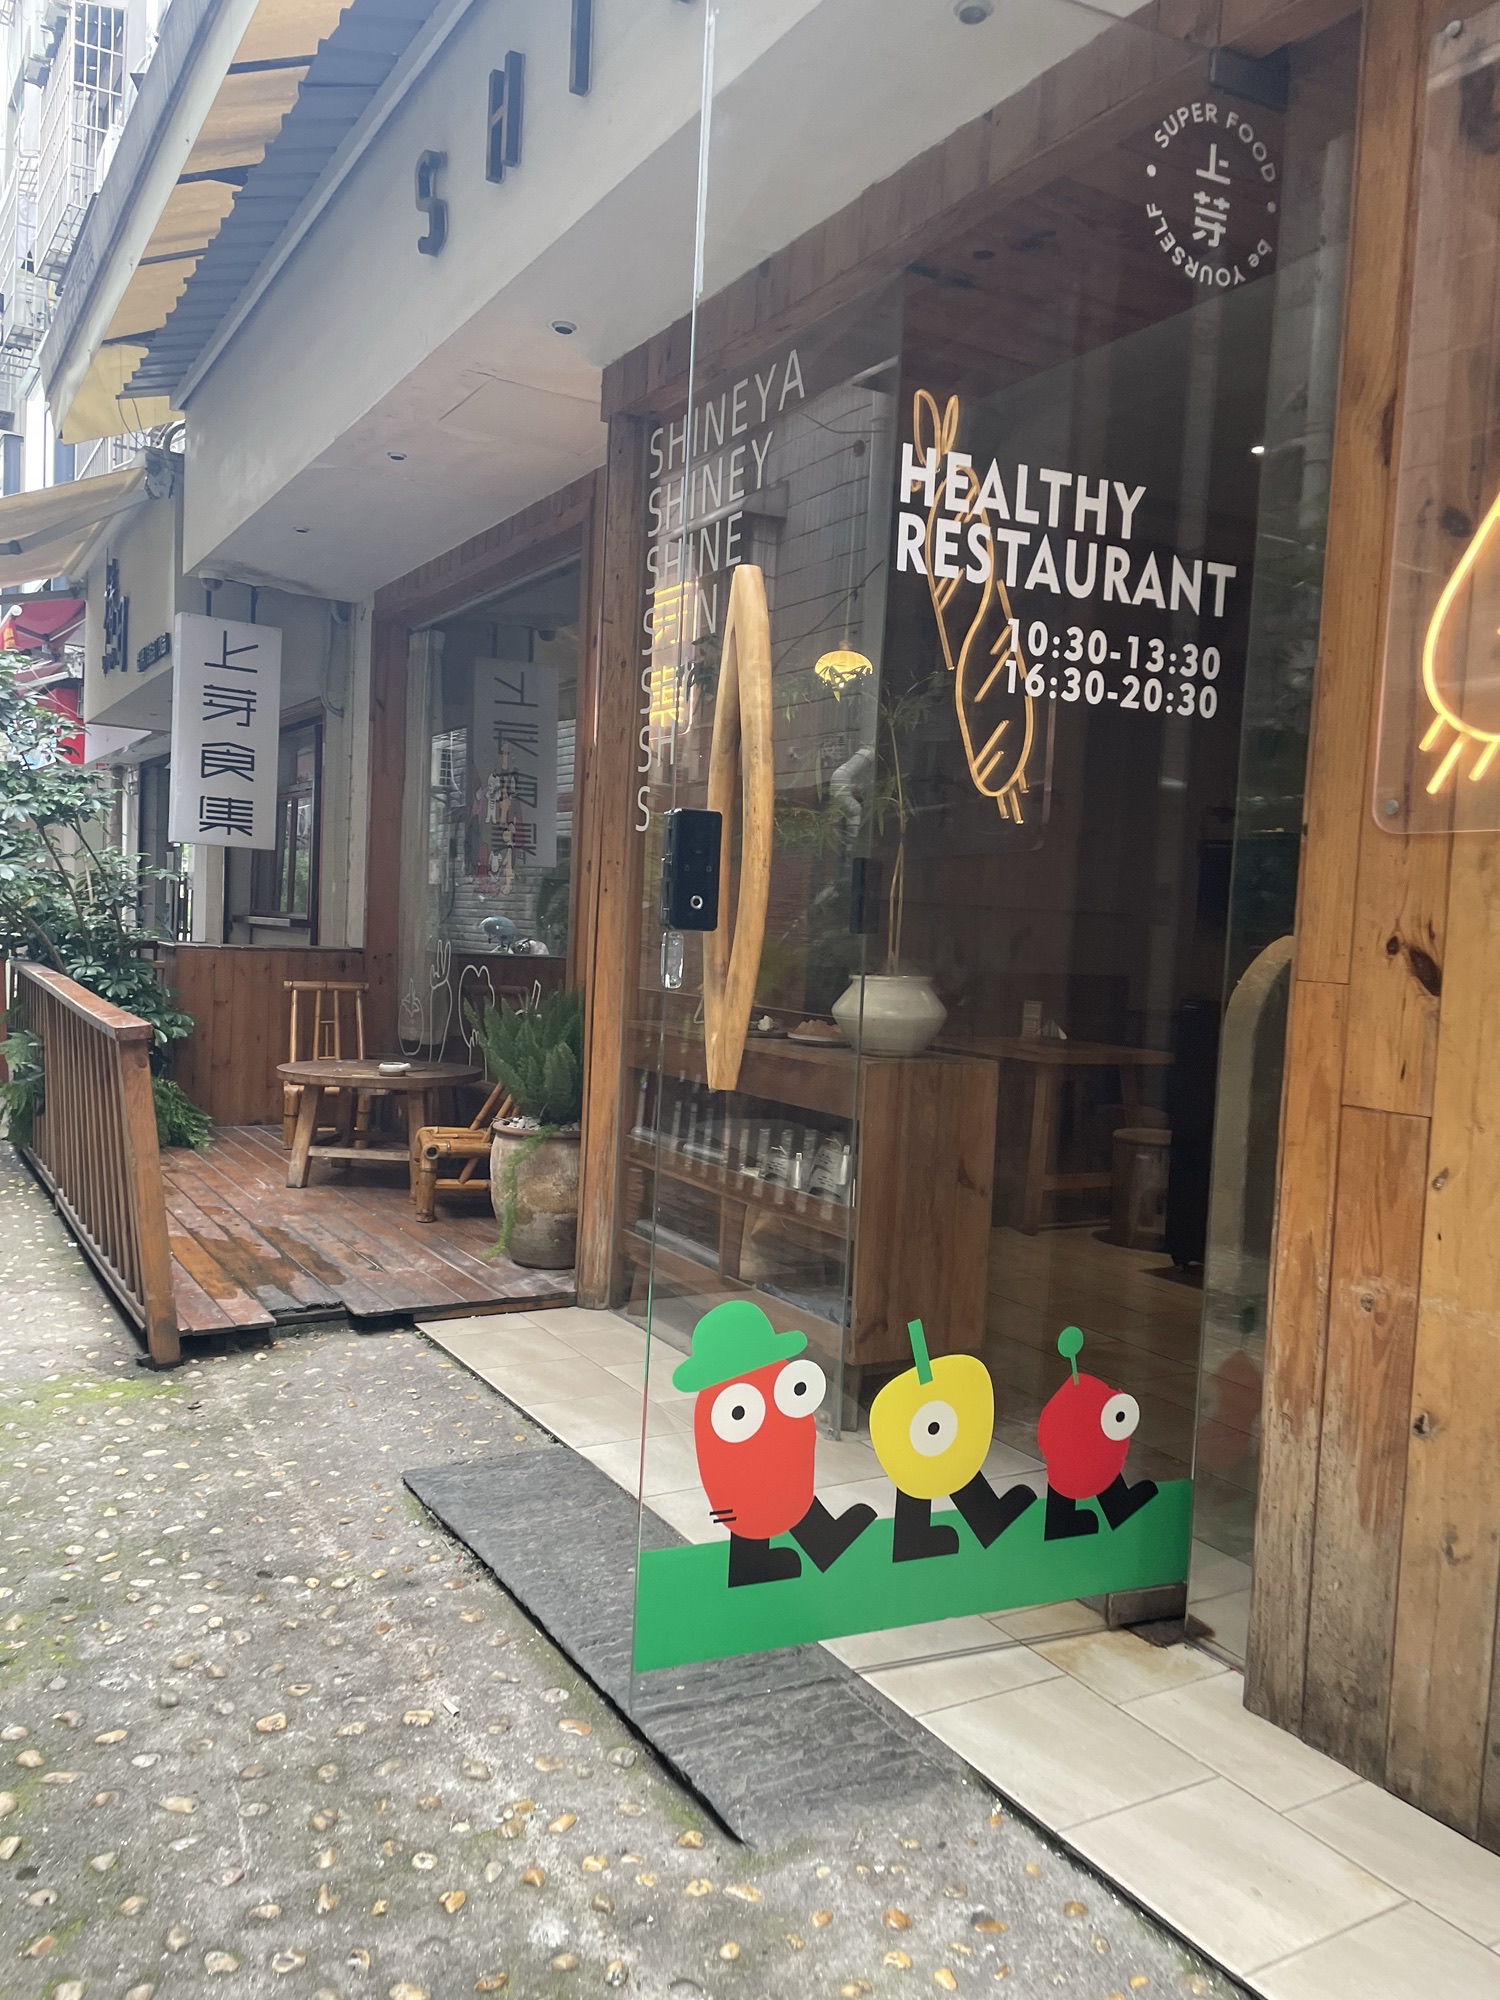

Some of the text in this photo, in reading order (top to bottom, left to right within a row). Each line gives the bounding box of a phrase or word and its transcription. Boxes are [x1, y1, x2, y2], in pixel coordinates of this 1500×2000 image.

[415, 0, 694, 257] SHI
[1155, 102, 1276, 183] SUPER FOOD
[1191, 143, 1231, 248] 上芽
[1146, 203, 1273, 287] be YOURSELF
[649, 349, 806, 480] SHINEYA
[647, 430, 774, 538] SHINEY
[900, 442, 1147, 540] HEALTHY
[645, 510, 743, 596] SHINE
[896, 511, 1237, 618] RESTAURANT
[1004, 659, 1219, 719] 16:30-20:30
[1007, 617, 1221, 681] 10:30-13:30
[199, 630, 259, 837] 上芽食集
[637, 719, 676, 773] SH
[635, 785, 651, 832] S
